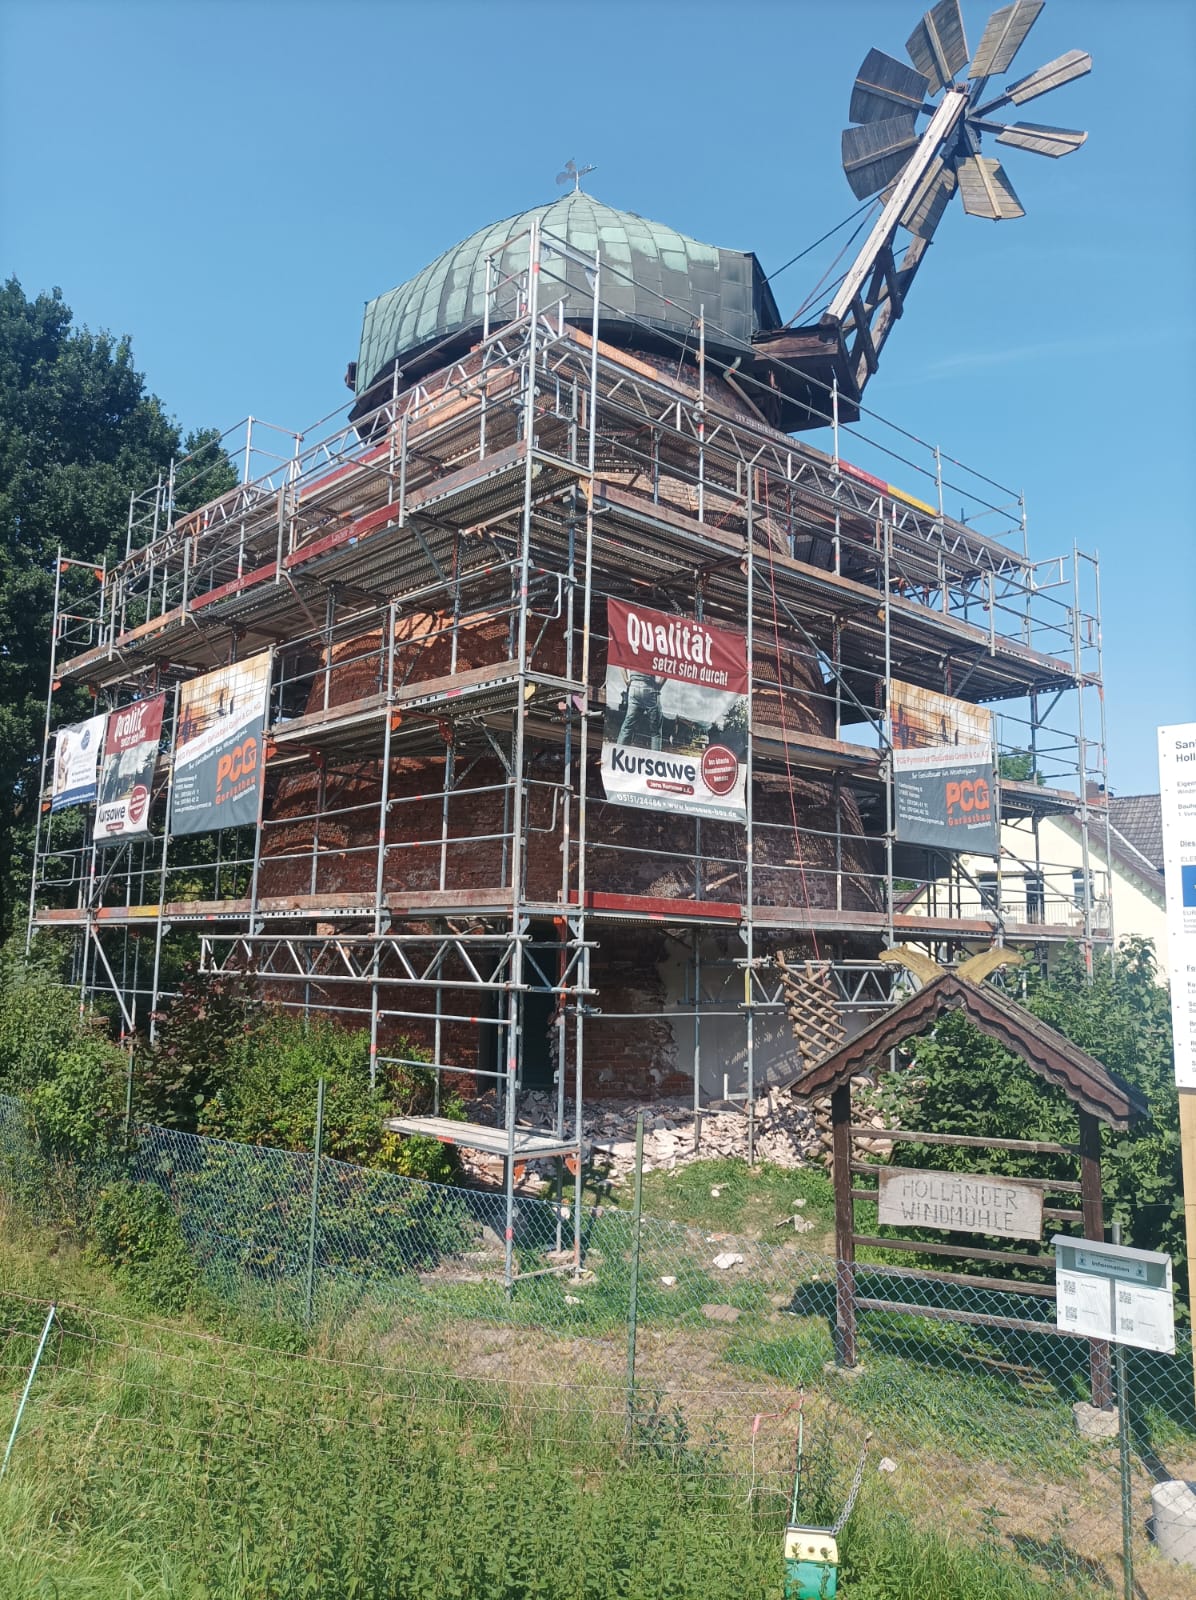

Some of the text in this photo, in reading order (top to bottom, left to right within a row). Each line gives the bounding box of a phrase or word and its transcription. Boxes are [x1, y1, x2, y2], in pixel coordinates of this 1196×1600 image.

[627, 612, 713, 666] Qualität
[652, 657, 728, 686] setzt sich durch!
[217, 737, 257, 793] PCG
[611, 747, 696, 782] Kursawe
[945, 778, 990, 815] PCG
